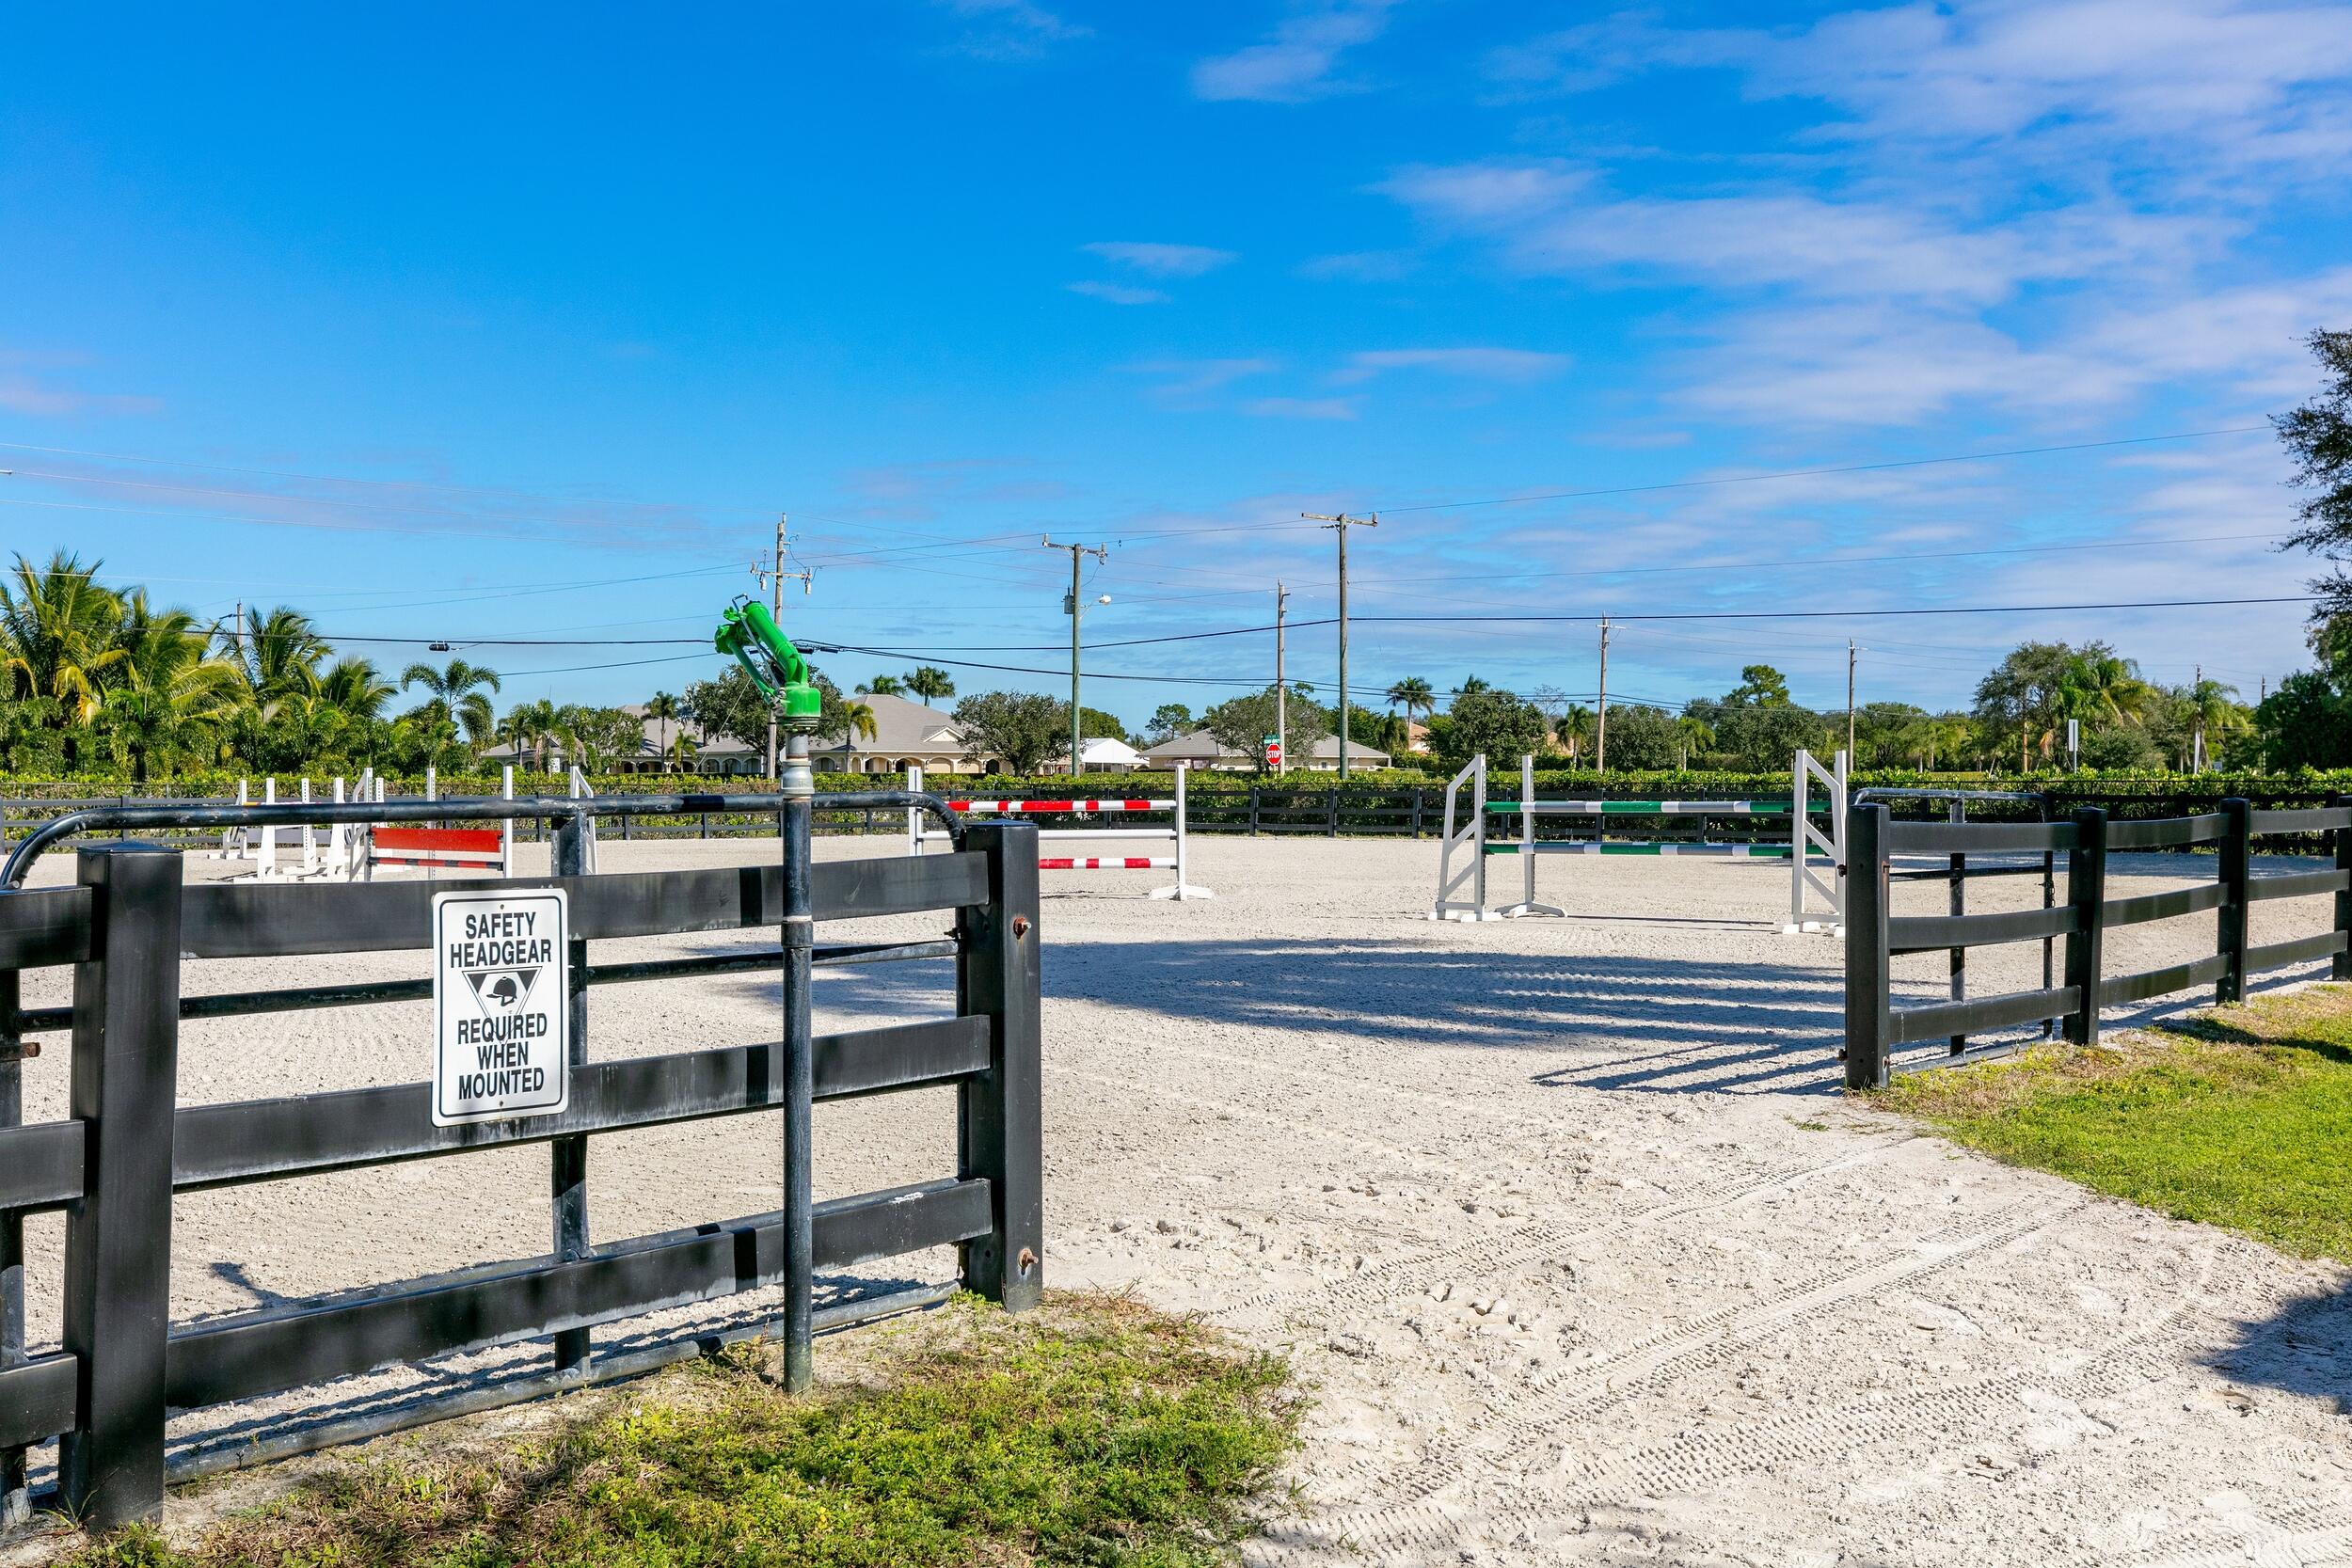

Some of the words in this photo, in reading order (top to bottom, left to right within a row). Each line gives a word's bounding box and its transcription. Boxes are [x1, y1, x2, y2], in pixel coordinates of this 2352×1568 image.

[466, 912, 536, 940] SAFETY
[450, 939, 551, 969] HEADGEAR
[457, 1013, 548, 1045] REQUIRED
[477, 1041, 529, 1070] WHEN
[458, 1068, 545, 1100] MOUNTED
